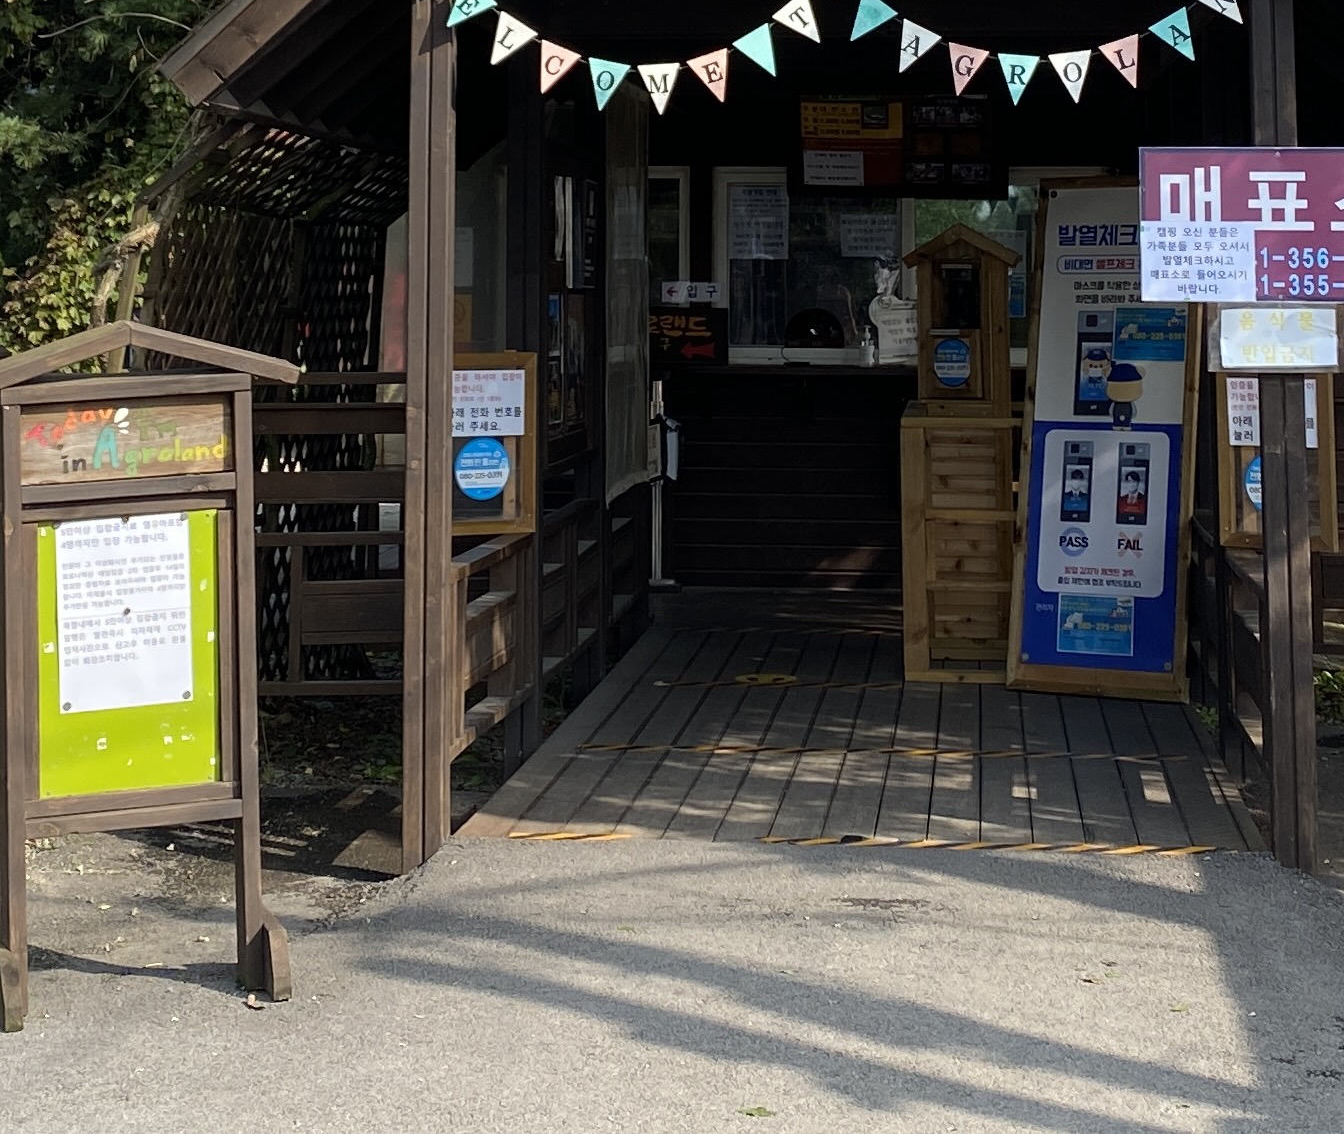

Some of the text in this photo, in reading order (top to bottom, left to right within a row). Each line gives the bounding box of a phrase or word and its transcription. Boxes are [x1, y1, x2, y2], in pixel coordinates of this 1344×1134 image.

[1156, 227, 1239, 238] 캠핑 오신 분들은
[1147, 241, 1250, 252] 가족분들 모두 오셔서
[1064, 258, 1135, 270] 비대면 셀프체크
[1162, 255, 1235, 266] 발열체크하시고
[1150, 269, 1248, 281] 매표소로 들어오시기
[1074, 281, 1105, 291] 마스크를
[1107, 280, 1131, 290] 착용한
[1177, 284, 1222, 295] 바랍니다.
[1075, 294, 1099, 304] 화면을
[1241, 344, 1314, 363] 반입금지
[470, 407, 490, 418] 전화
[495, 406, 523, 418] 번호를
[1232, 416, 1253, 427] 아래
[1234, 429, 1253, 442] 눌러
[60, 424, 229, 477] in Agroland
[1059, 536, 1143, 551] PASS FAIL
[167, 623, 186, 632] CCTV
